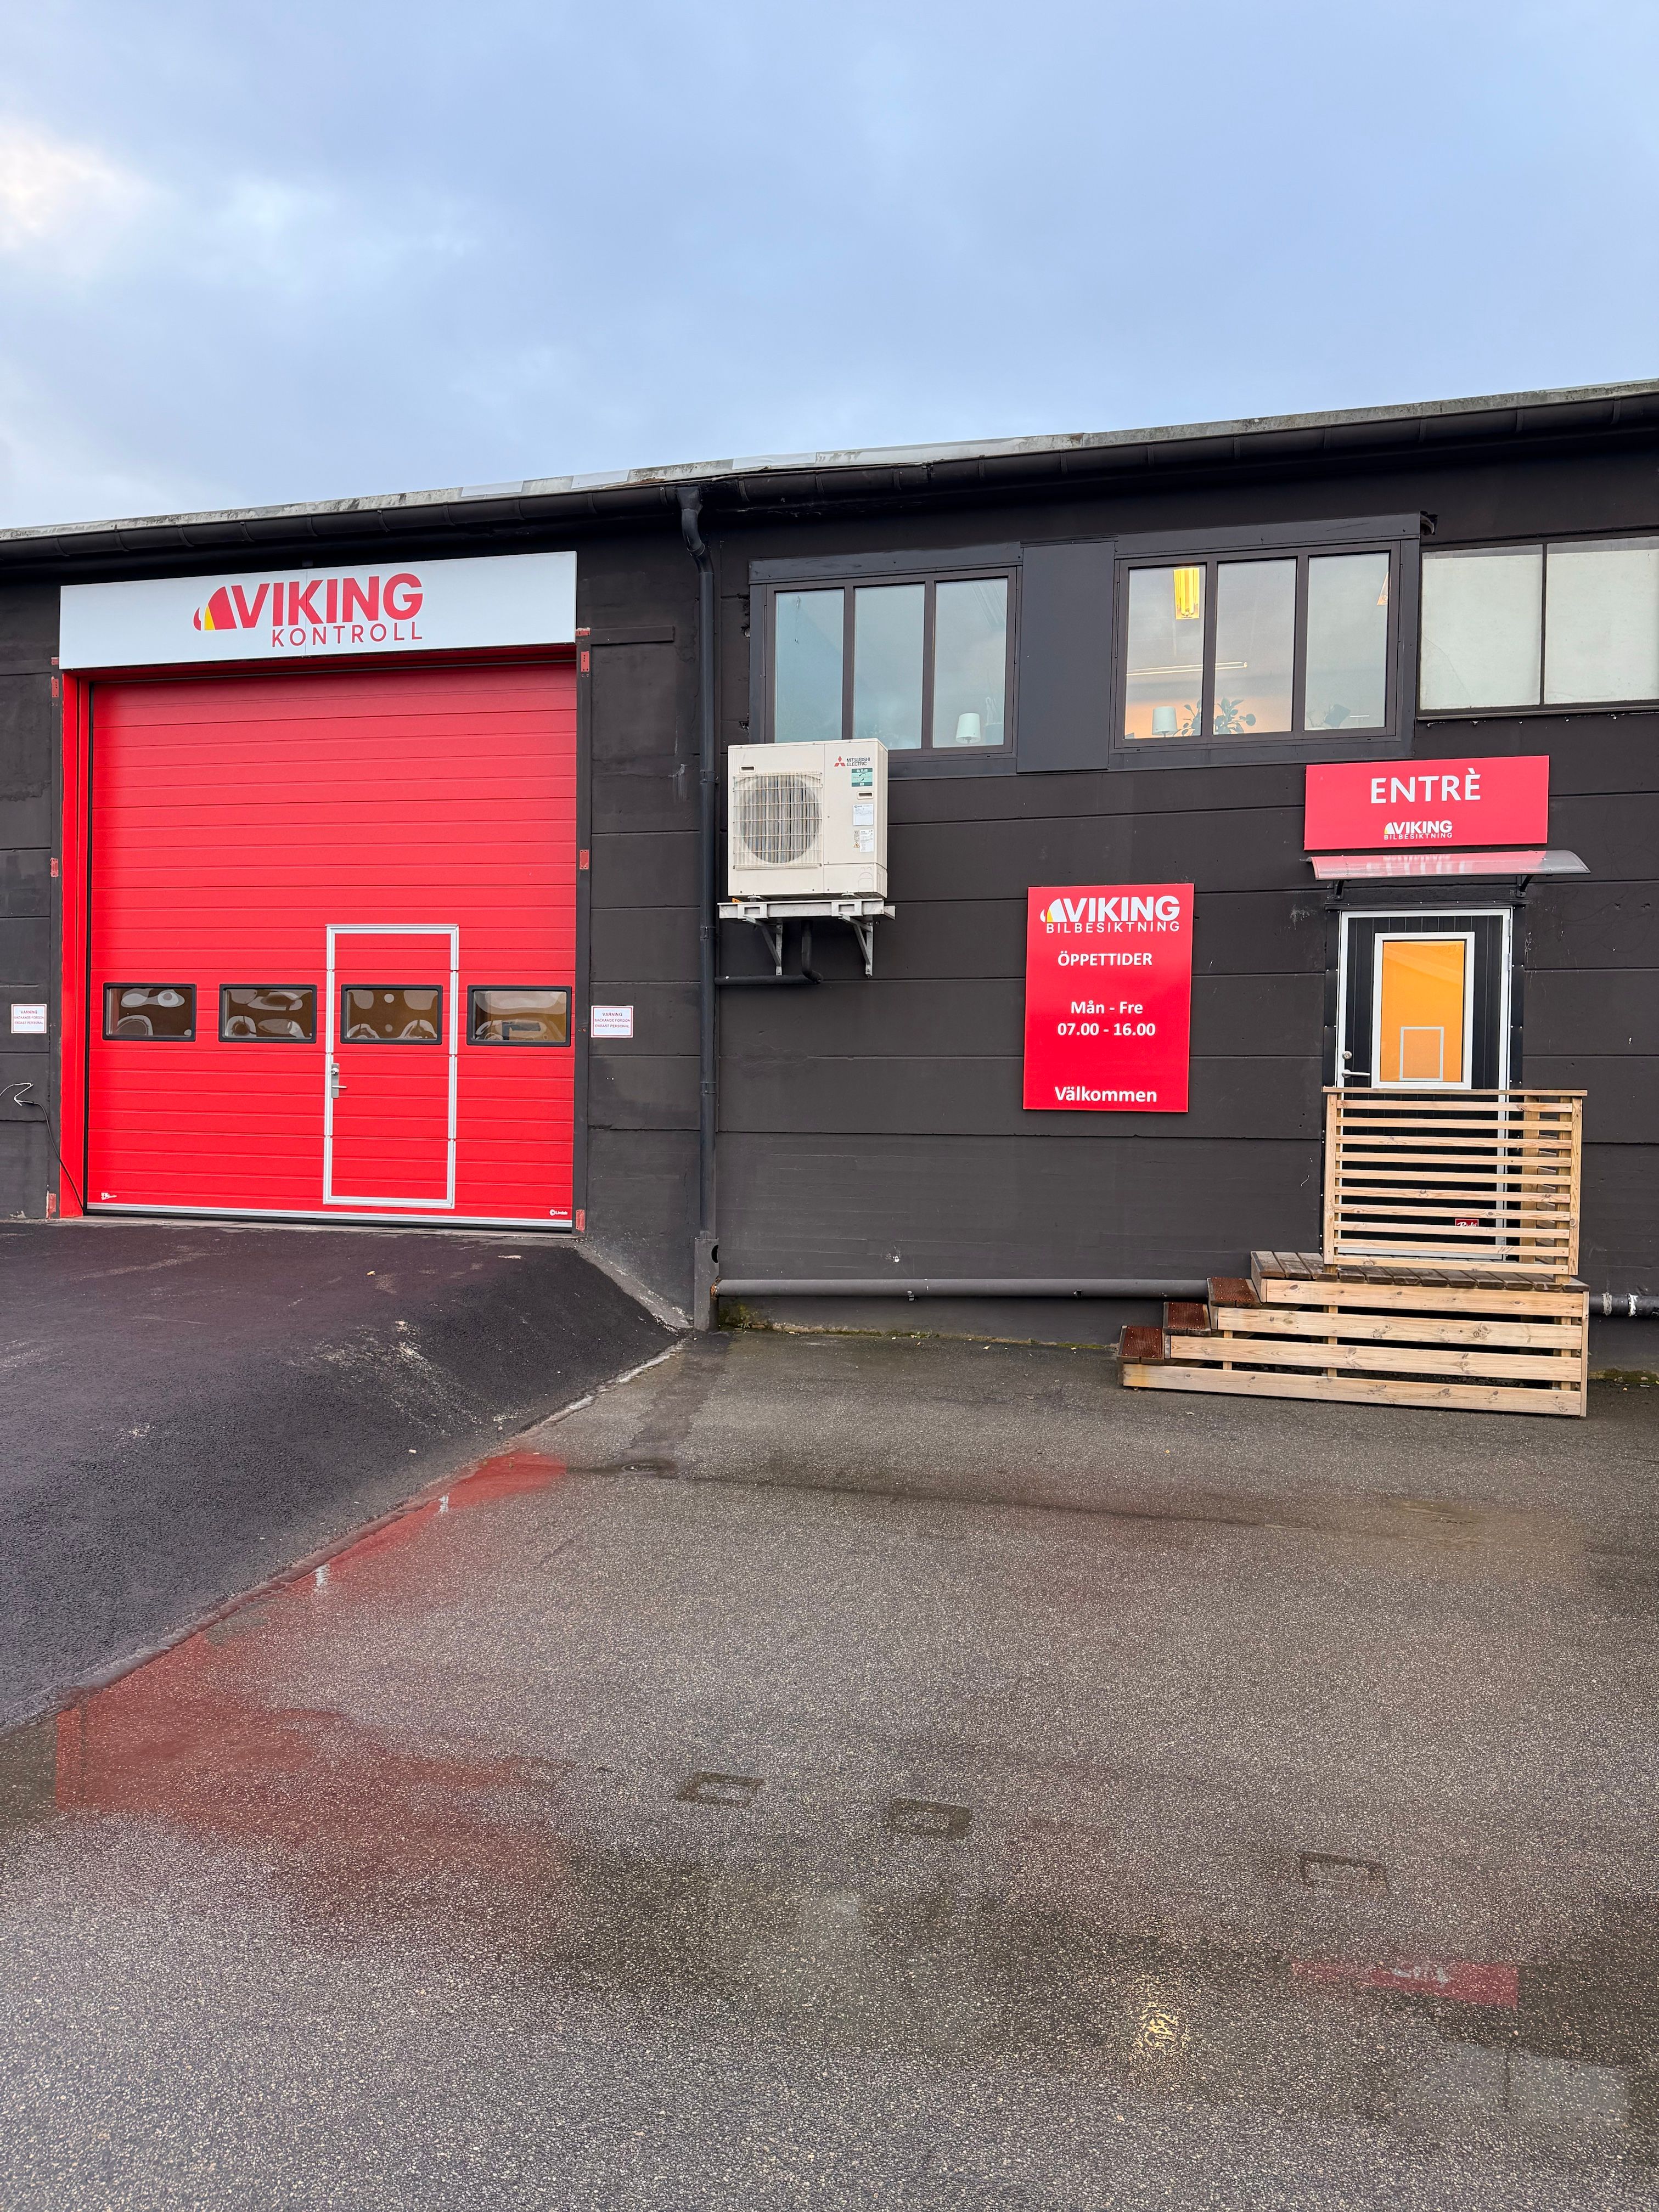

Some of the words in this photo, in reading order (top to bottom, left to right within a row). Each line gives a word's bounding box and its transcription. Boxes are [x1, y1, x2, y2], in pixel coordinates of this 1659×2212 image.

[231, 573, 423, 629] VIKING
[272, 621, 423, 648] KONTROLL
[1370, 767, 1481, 804] ENTRÈ
[1392, 820, 1453, 834] VIKING
[1063, 895, 1180, 922] VIKING
[1046, 921, 1180, 934] BILBESIKTNING
[1058, 950, 1153, 967] ÖPPETTIDER
[1071, 1000, 1105, 1015] Mån
[1120, 1001, 1144, 1015] Fre
[1057, 1023, 1100, 1037] 07.00
[1114, 1023, 1156, 1037] 16.00
[1054, 1086, 1158, 1103] Välkommen
